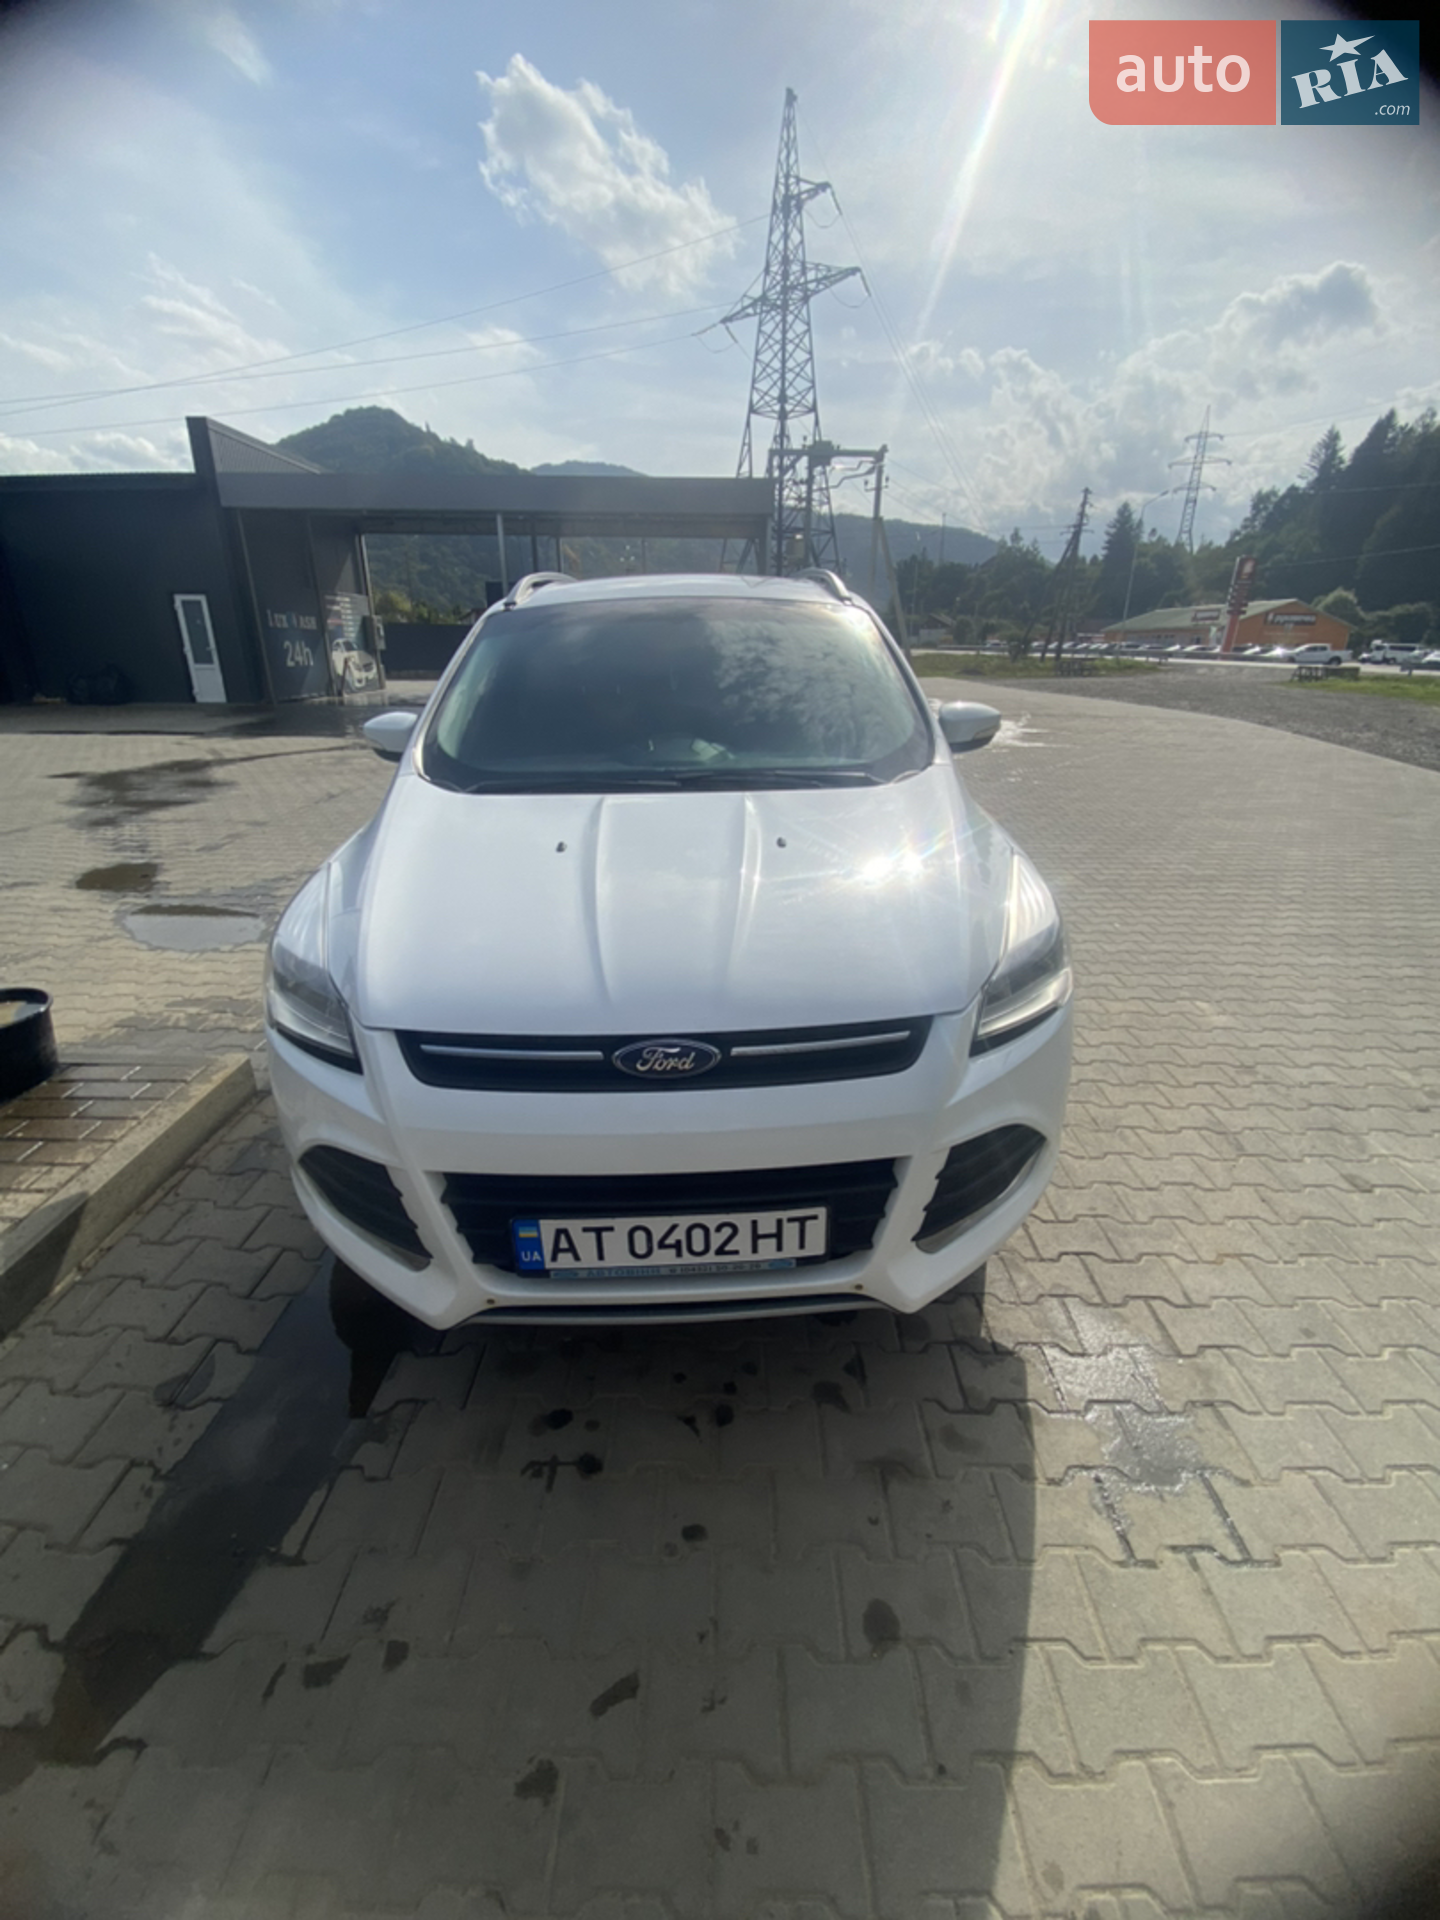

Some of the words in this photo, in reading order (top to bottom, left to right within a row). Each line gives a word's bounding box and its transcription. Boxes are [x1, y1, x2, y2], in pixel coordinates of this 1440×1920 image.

[283, 640, 315, 667] 24h
[635, 1046, 696, 1072] Ford
[550, 1225, 615, 1263] AT
[627, 1221, 741, 1260] 0402
[750, 1214, 820, 1254] HT
[521, 1250, 542, 1262] UA
